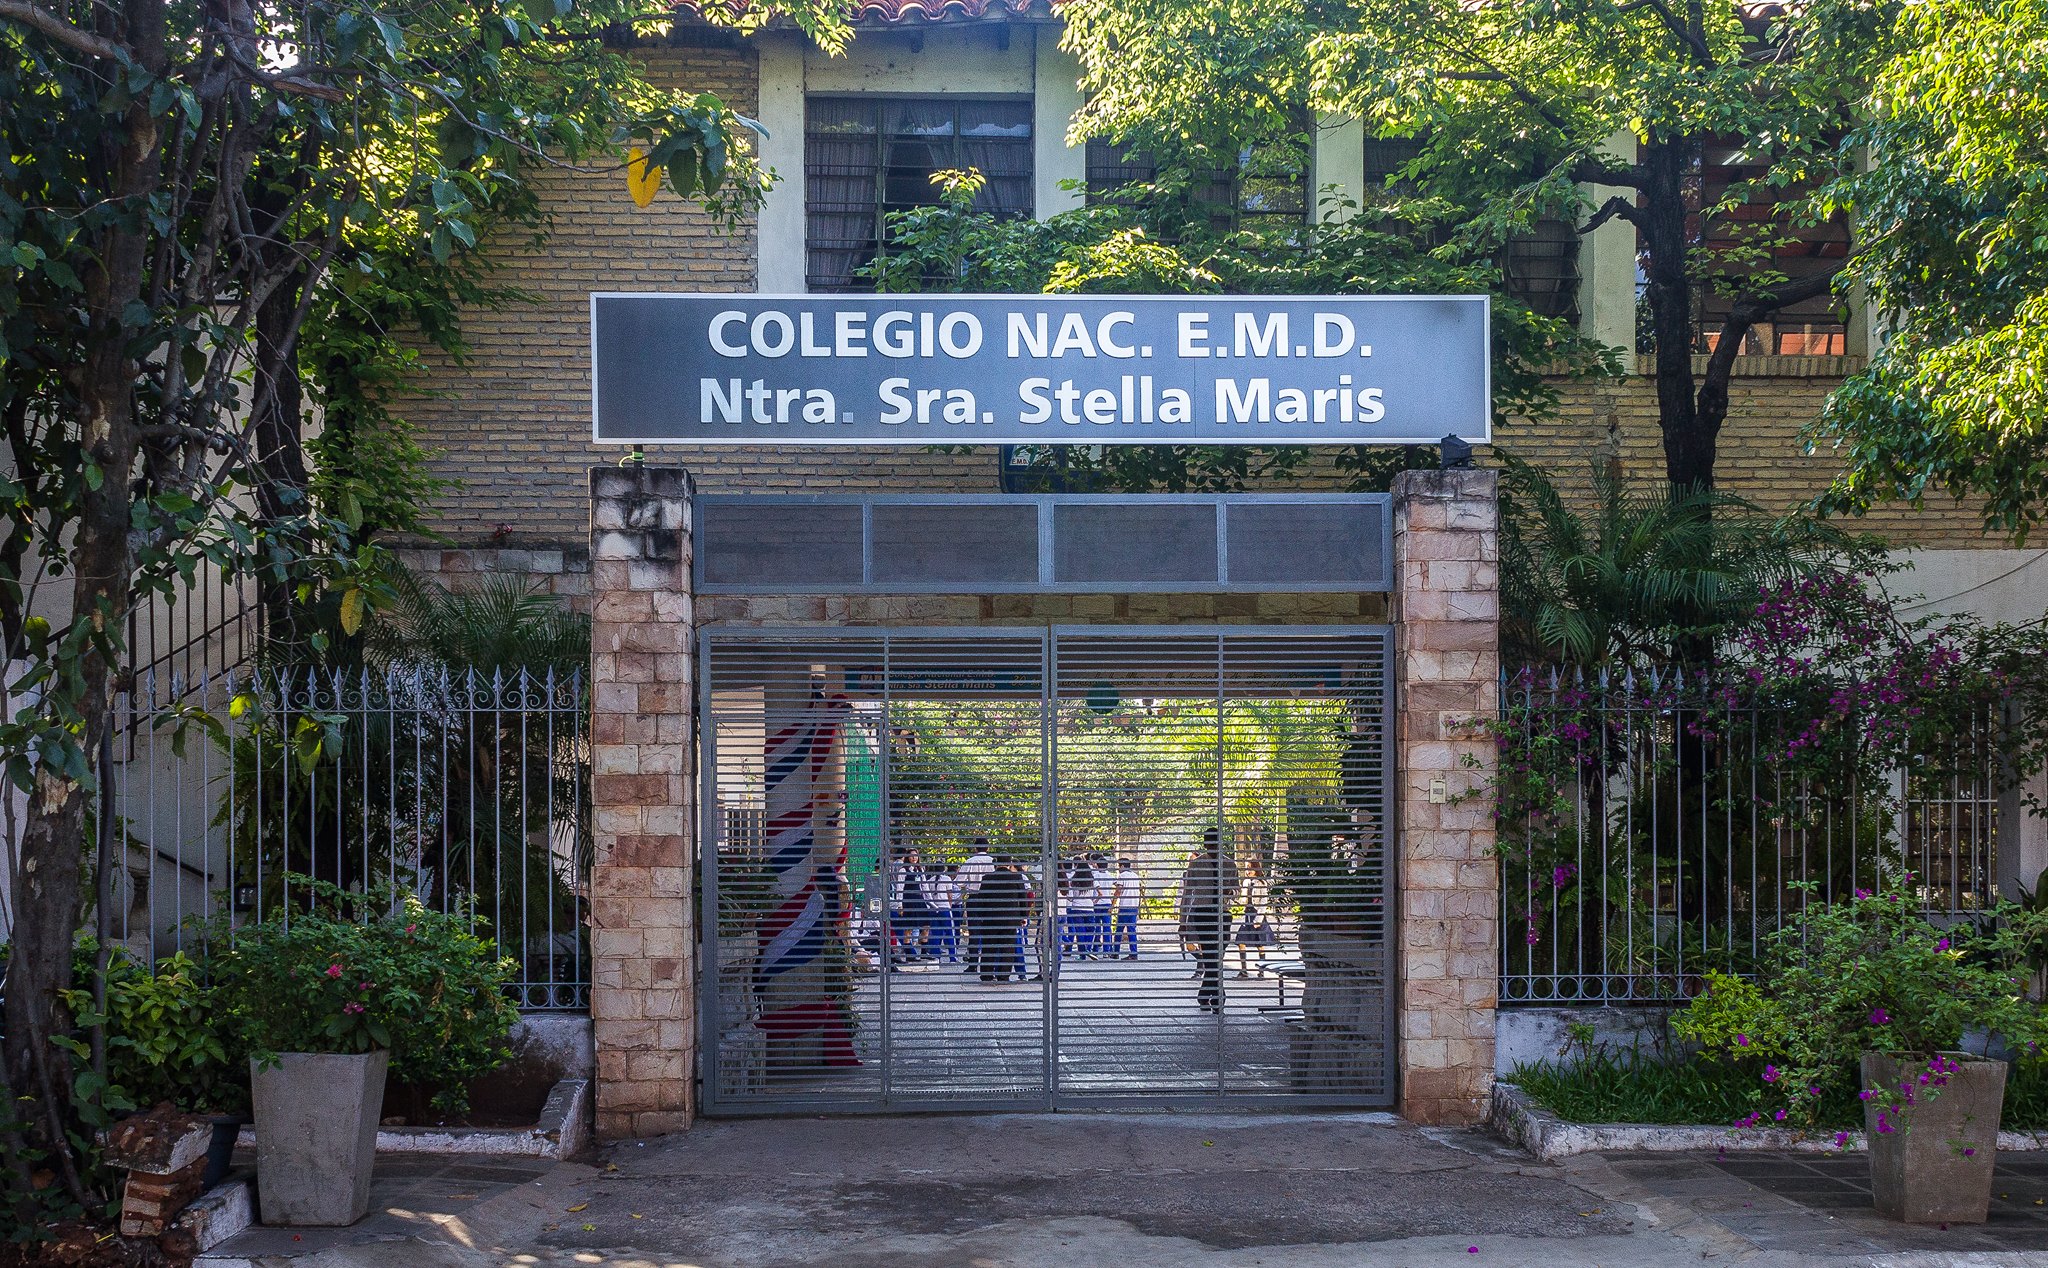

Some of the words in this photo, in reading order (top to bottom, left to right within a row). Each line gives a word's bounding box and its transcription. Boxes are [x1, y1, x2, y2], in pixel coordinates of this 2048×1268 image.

[708, 310, 983, 358] COLEGIO
[1007, 311, 1153, 358] NAC.
[1178, 311, 1373, 358] E.M.D.
[699, 378, 854, 425] Ntra.
[878, 377, 994, 425] Sra.
[1019, 375, 1191, 425] Stella
[1215, 374, 1385, 425] Maris
